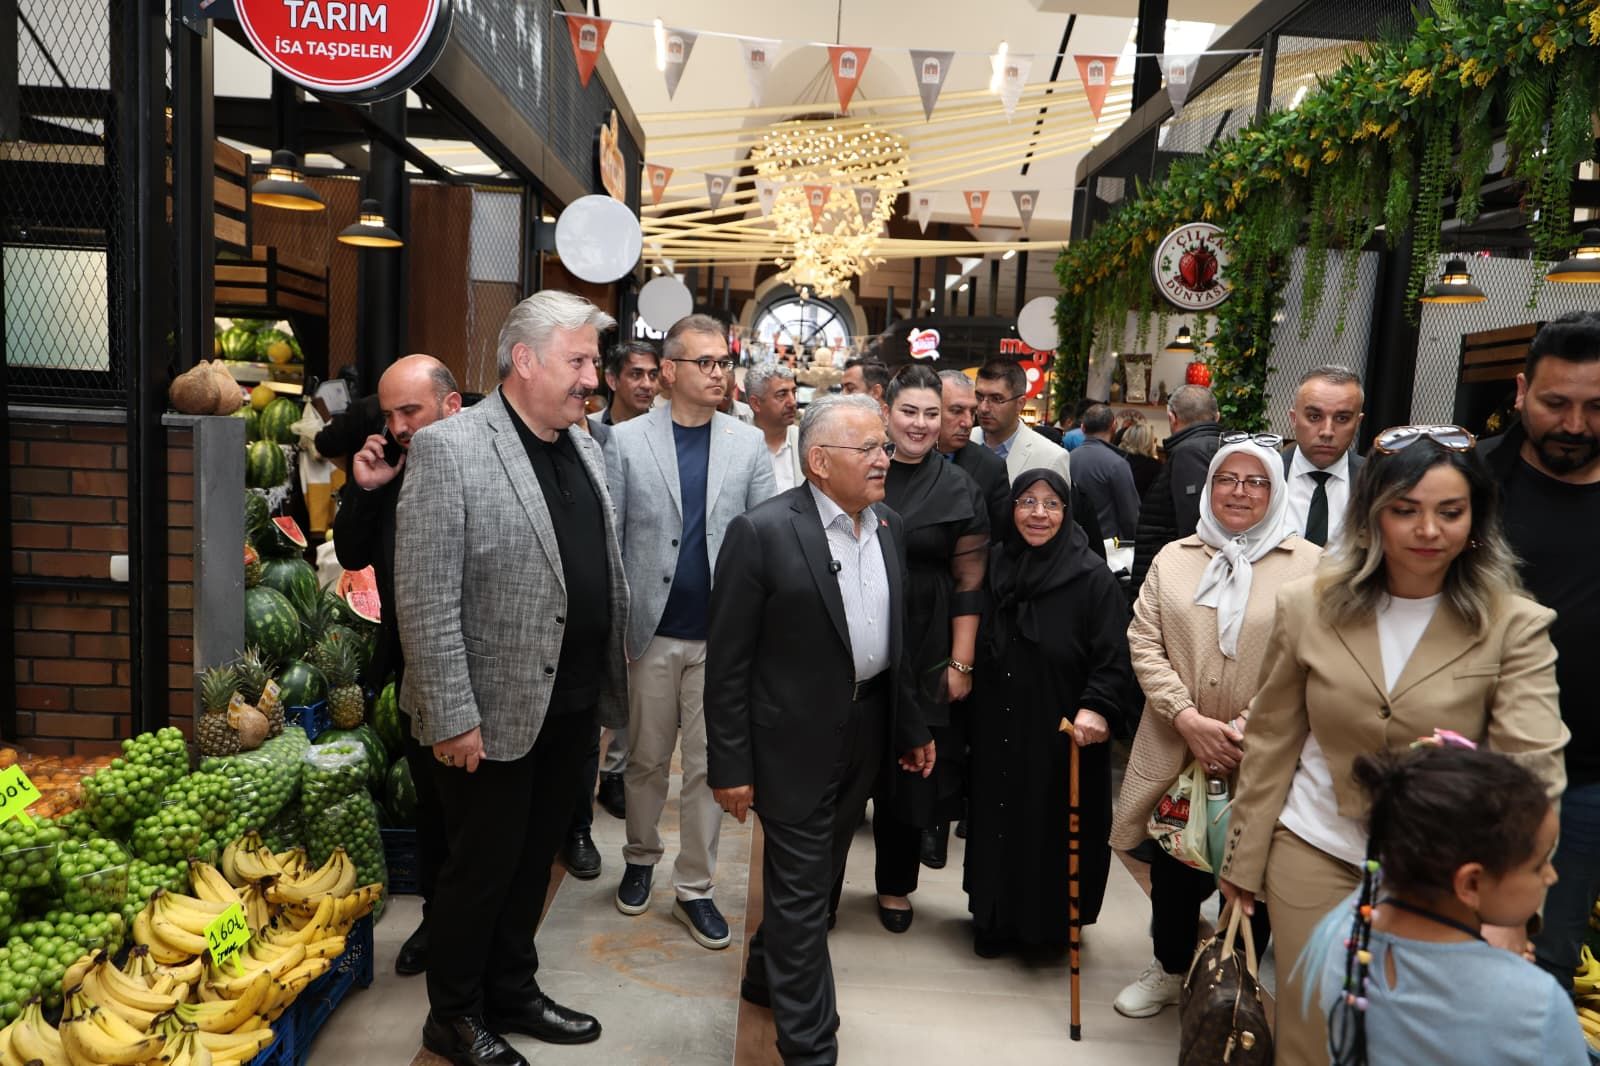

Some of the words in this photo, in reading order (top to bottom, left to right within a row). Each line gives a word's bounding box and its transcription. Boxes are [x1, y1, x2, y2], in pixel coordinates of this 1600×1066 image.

[283, 0, 387, 33] TARIM
[275, 35, 304, 55] İSA
[306, 40, 393, 60] TAŞDELEN
[1166, 280, 1226, 302] DÜNYASI
